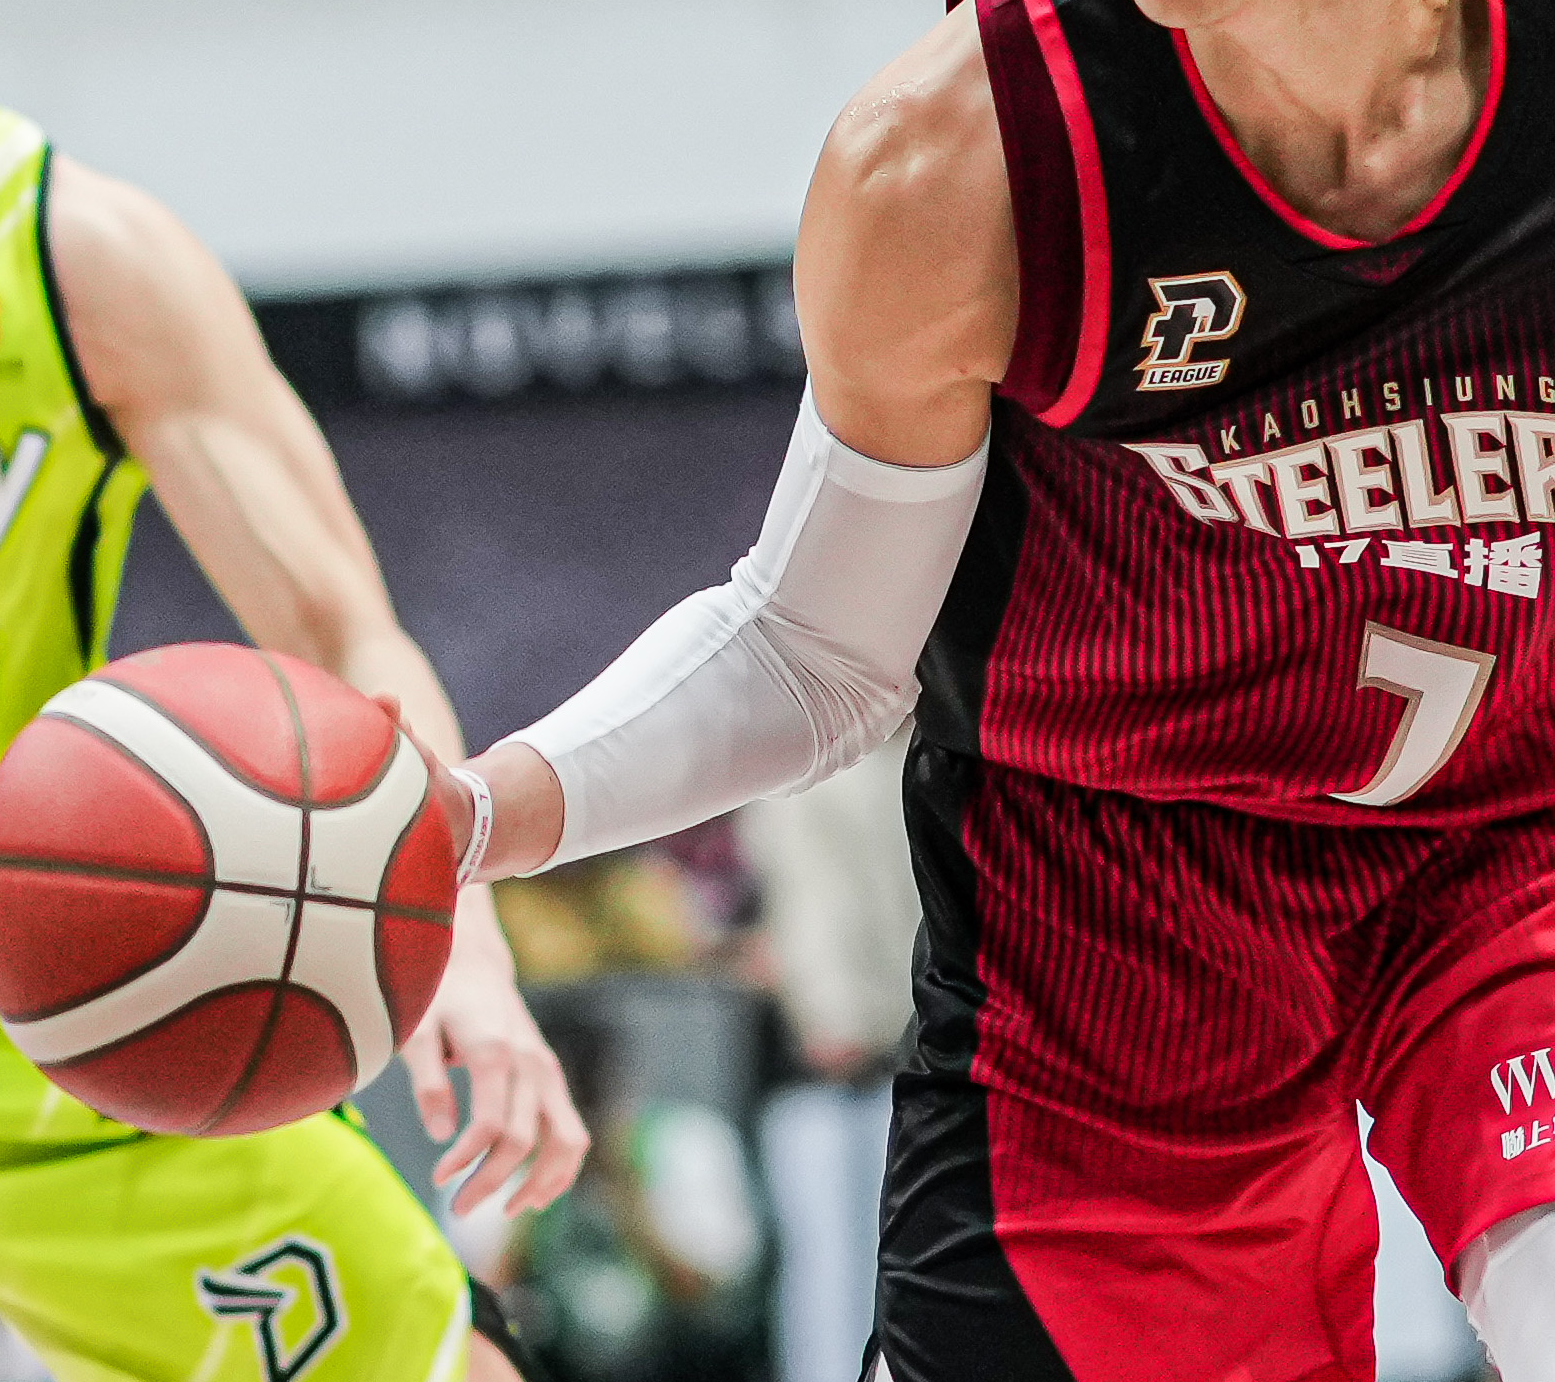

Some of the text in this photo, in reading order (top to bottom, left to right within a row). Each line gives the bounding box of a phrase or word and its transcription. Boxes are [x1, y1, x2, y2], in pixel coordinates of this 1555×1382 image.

[1147, 364, 1221, 385] LEAGUE
[1221, 375, 1555, 455] KAOHSIUNG
[1295, 531, 1543, 599] 17直播
[1328, 620, 1497, 808] 7
